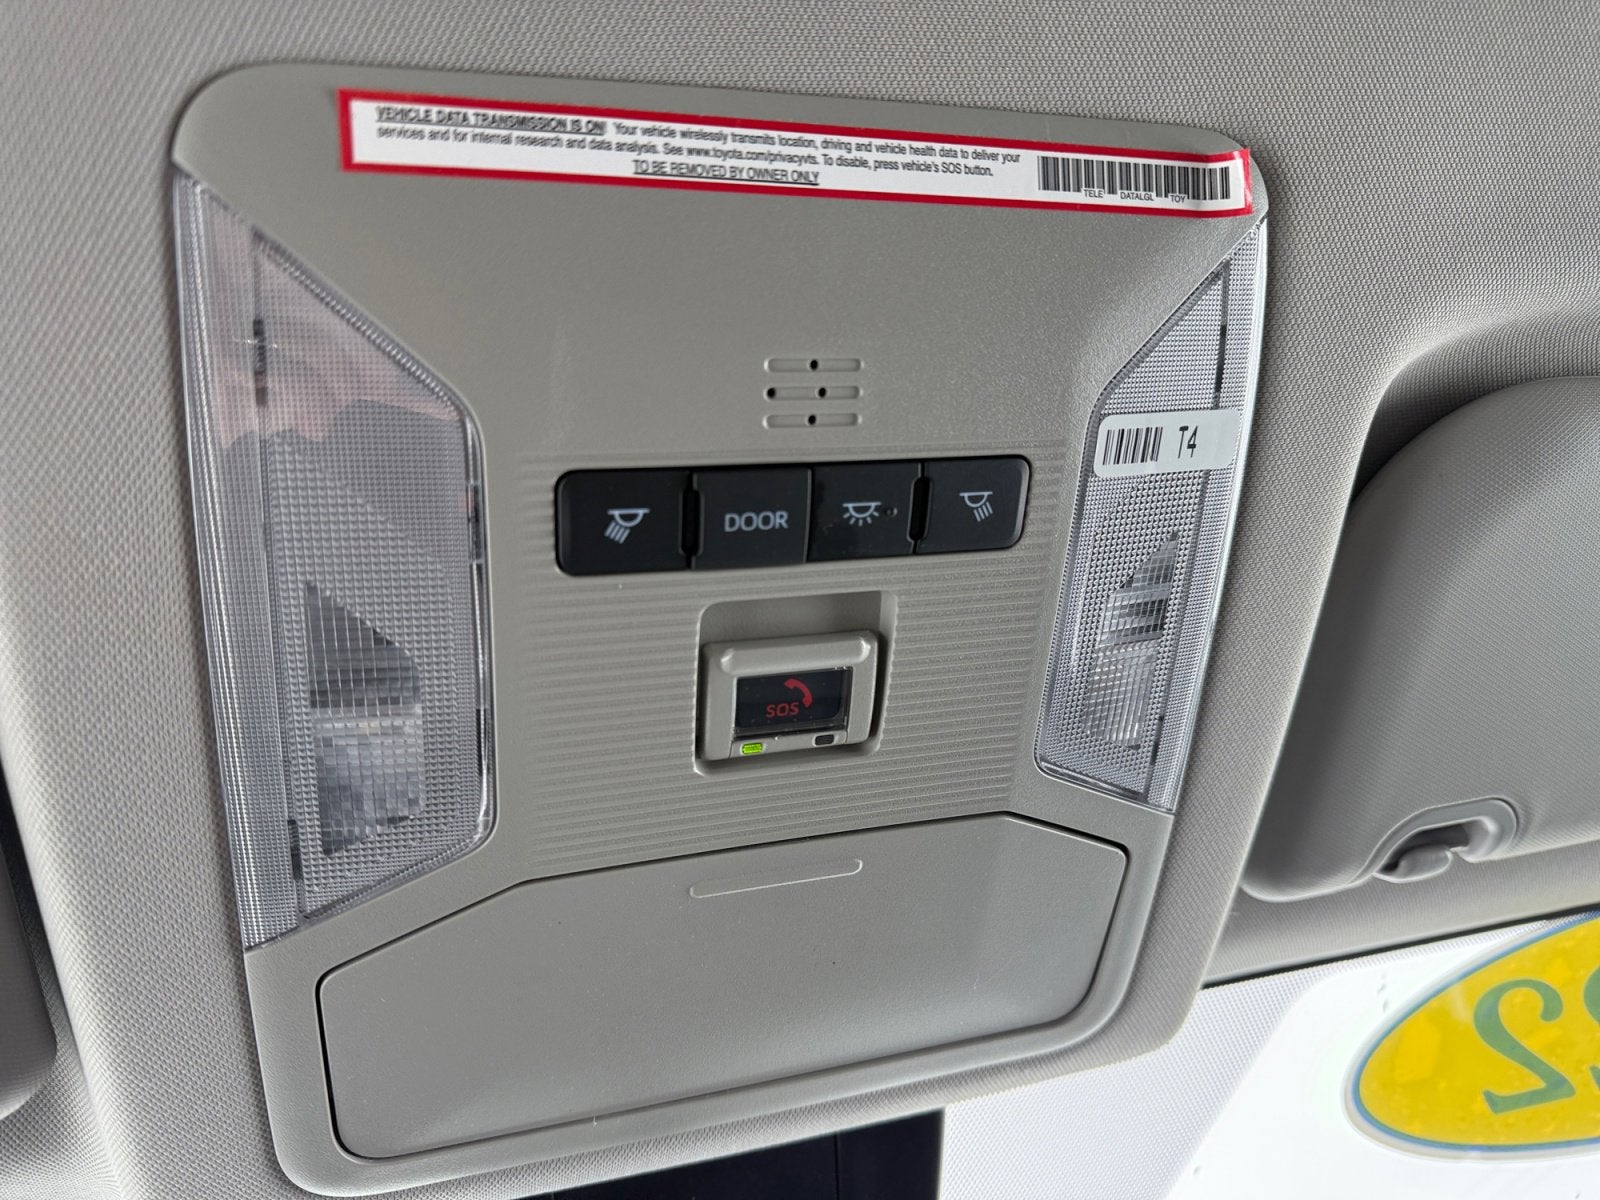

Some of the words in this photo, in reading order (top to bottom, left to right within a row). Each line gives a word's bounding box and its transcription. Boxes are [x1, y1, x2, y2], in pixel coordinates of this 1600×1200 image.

[376, 106, 433, 123] VEHICLE
[436, 110, 468, 125] DATA
[472, 112, 566, 131] TRANSMISSION
[571, 119, 582, 132] IS
[613, 121, 638, 136] Your
[641, 125, 677, 138] vehicle
[680, 128, 728, 144] wirelessly
[731, 132, 775, 145] transmits
[778, 134, 818, 149] location,
[821, 140, 851, 154] driving
[855, 140, 872, 152] and
[874, 142, 907, 154] vehicle
[909, 144, 936, 157] health
[939, 146, 958, 158] data
[960, 148, 969, 159] to
[971, 148, 999, 161] deliver
[1001, 152, 1020, 165] your
[376, 126, 425, 140] services
[428, 128, 449, 141] and
[452, 129, 468, 142] for
[471, 130, 512, 145] internal
[515, 133, 563, 148] research
[565, 136, 586, 149] and
[589, 138, 612, 151] data
[615, 139, 658, 156] analysis.
[662, 142, 684, 155] See
[686, 146, 819, 165] www.toyota.com/privacyvts.
[822, 154, 833, 166] To
[836, 155, 871, 170] disable,
[873, 159, 899, 171] press
[901, 159, 939, 173] vehicle's
[941, 162, 962, 174] SOS
[964, 163, 993, 177] button.
[633, 160, 649, 174] TO
[651, 160, 668, 175] BE
[670, 162, 727, 178] REMOVED
[730, 166, 745, 180] BY
[747, 167, 788, 182] OWNER
[790, 170, 820, 185] ONLY
[1084, 189, 1104, 198] TELE
[1170, 194, 1186, 203] TOY
[1178, 425, 1199, 459] T4
[724, 511, 789, 532] DOOR
[766, 701, 800, 718] SOS
